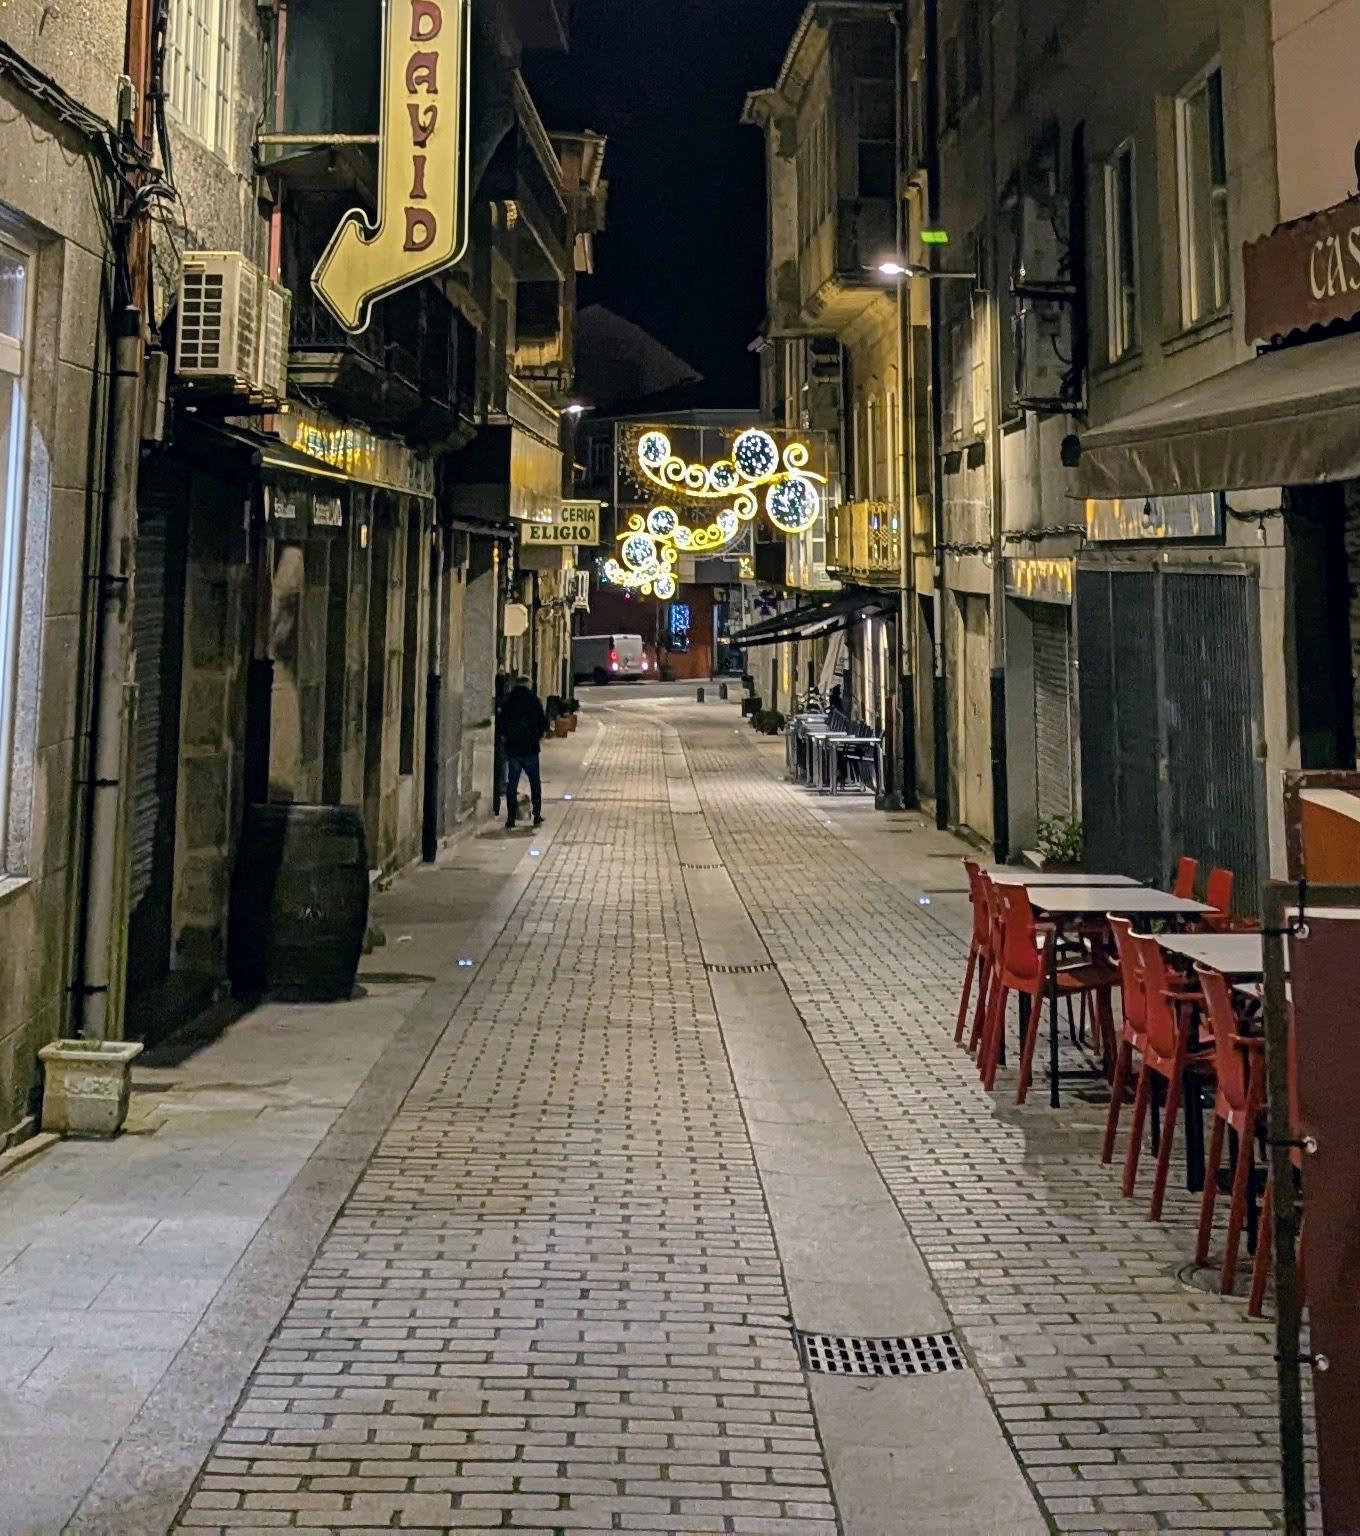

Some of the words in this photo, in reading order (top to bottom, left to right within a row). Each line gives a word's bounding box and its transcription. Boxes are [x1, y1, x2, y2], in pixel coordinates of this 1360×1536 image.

[403, 0, 443, 252] DAVID
[561, 507, 596, 523] CERIA
[529, 525, 591, 540] ELIGIO
